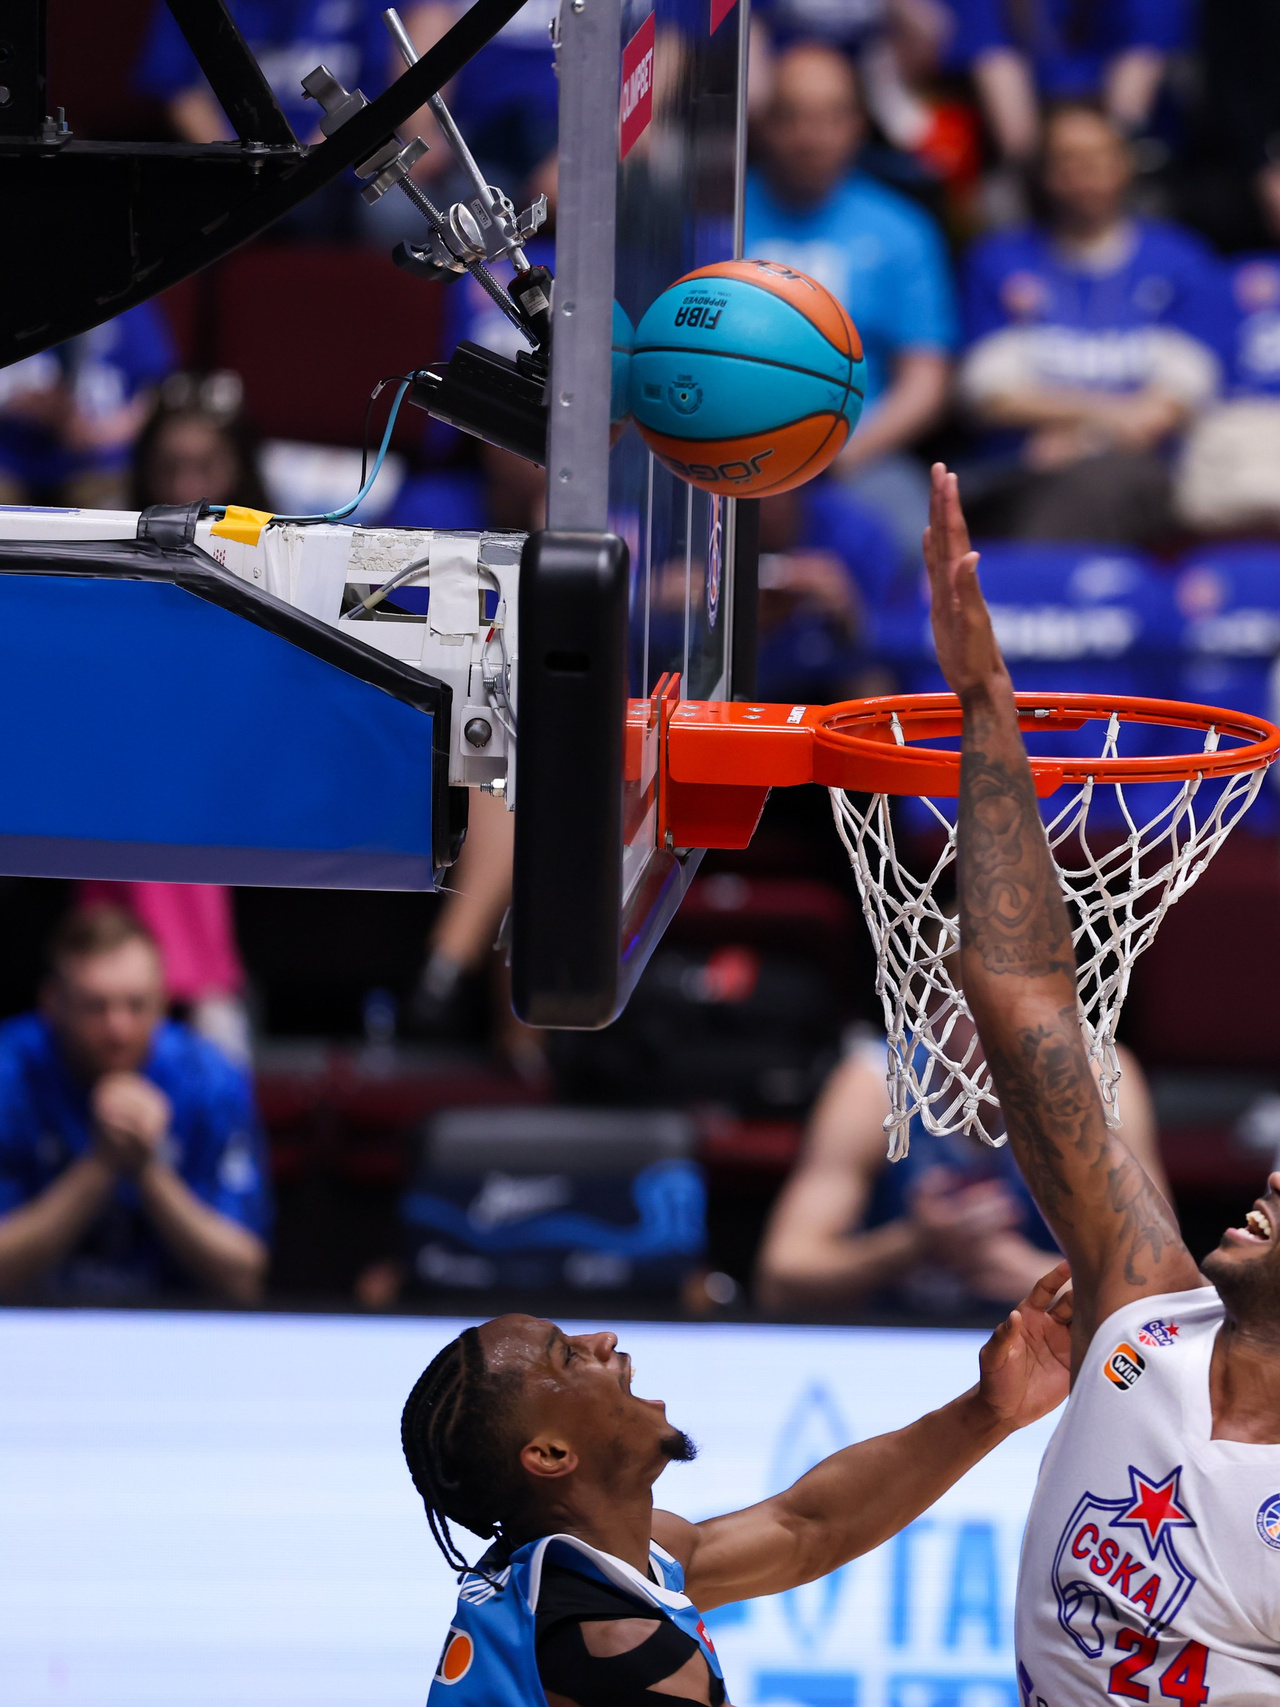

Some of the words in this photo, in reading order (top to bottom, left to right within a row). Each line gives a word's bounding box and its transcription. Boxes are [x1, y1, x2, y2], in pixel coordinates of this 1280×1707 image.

[674, 306, 722, 330] FIBA
[682, 296, 727, 308] APPROVED
[660, 448, 774, 485] JÖGE
[1114, 1355, 1139, 1383] Win
[1072, 1523, 1161, 1616] CSKA
[1108, 1627, 1209, 1707] 24
